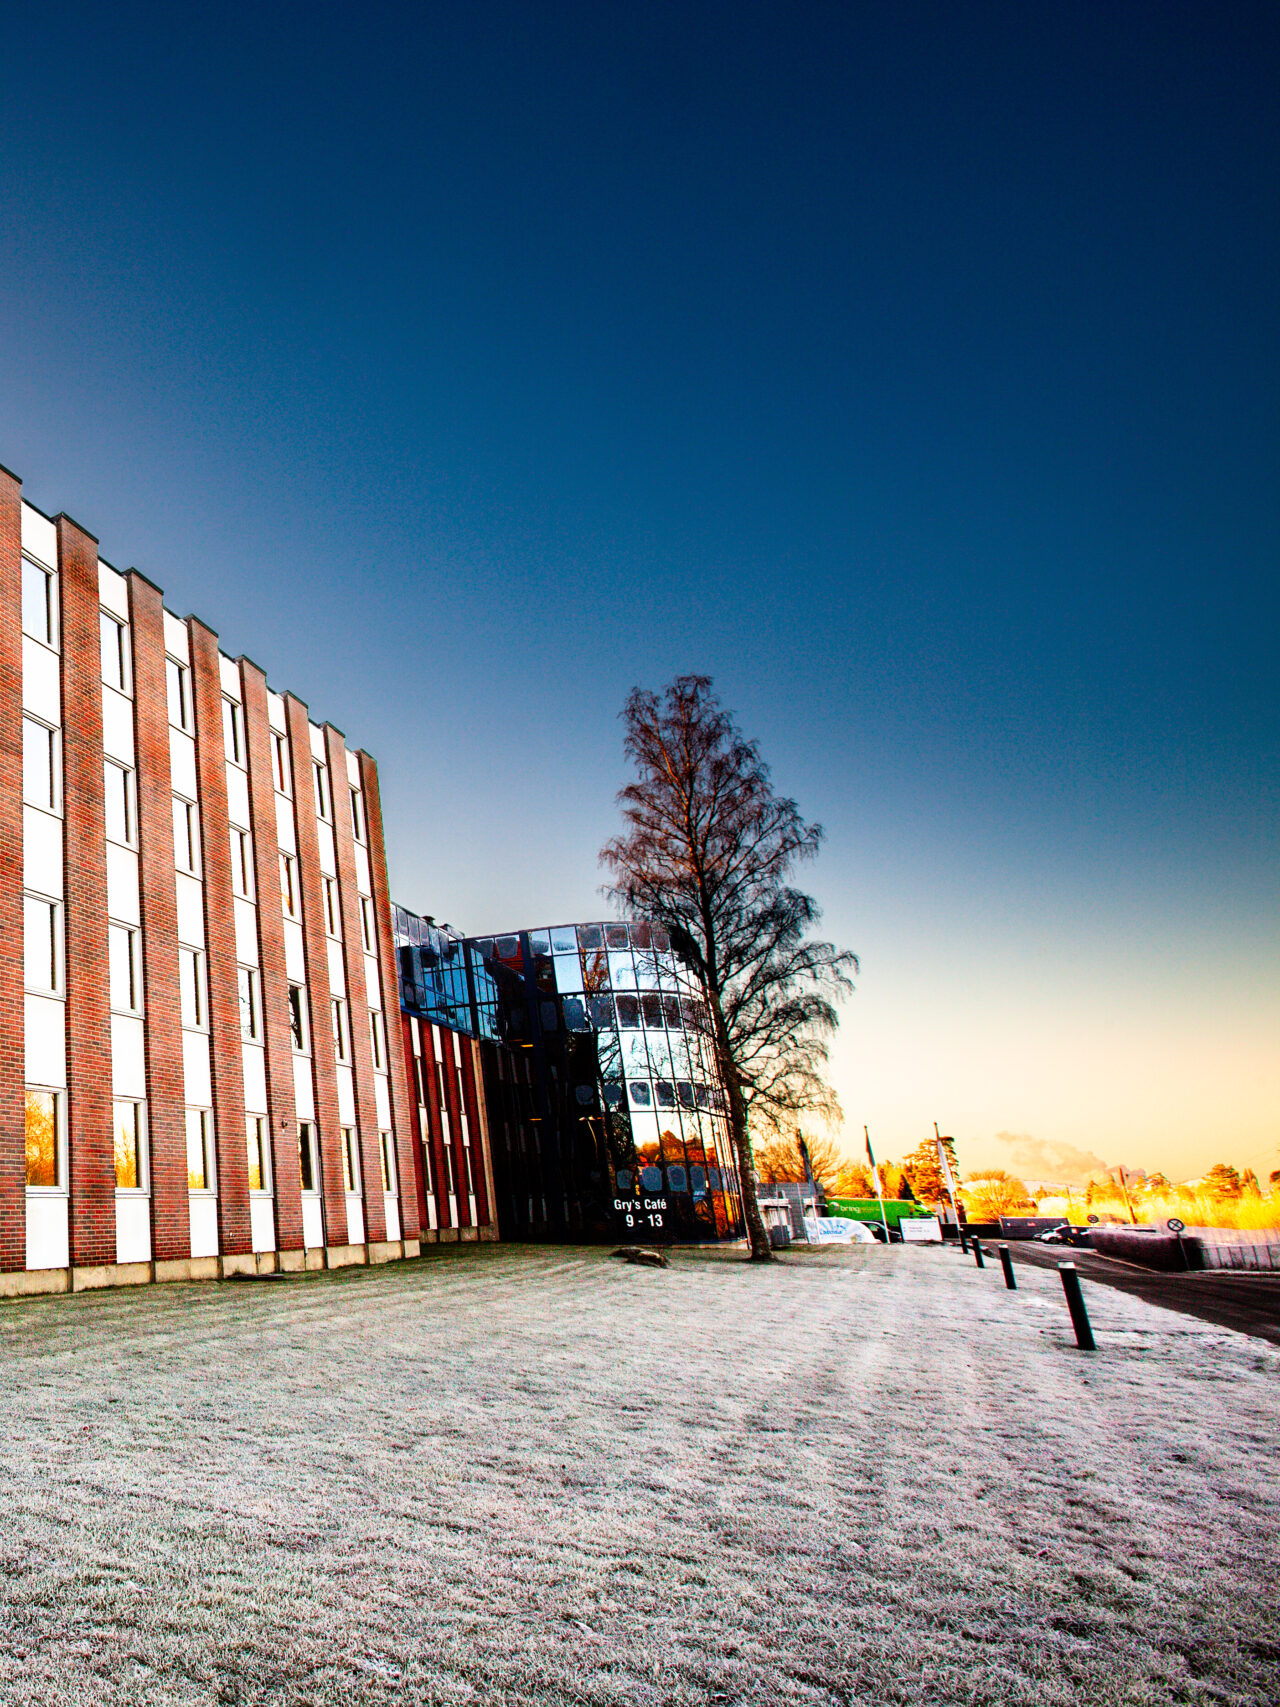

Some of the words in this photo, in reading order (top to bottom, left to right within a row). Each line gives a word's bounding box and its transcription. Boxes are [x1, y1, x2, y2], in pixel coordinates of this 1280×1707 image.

[613, 1199, 641, 1212] Gry's
[644, 1198, 667, 1210] Café
[840, 1205, 860, 1214] bring
[625, 1214, 634, 1227] 9
[647, 1213, 663, 1227] 13
